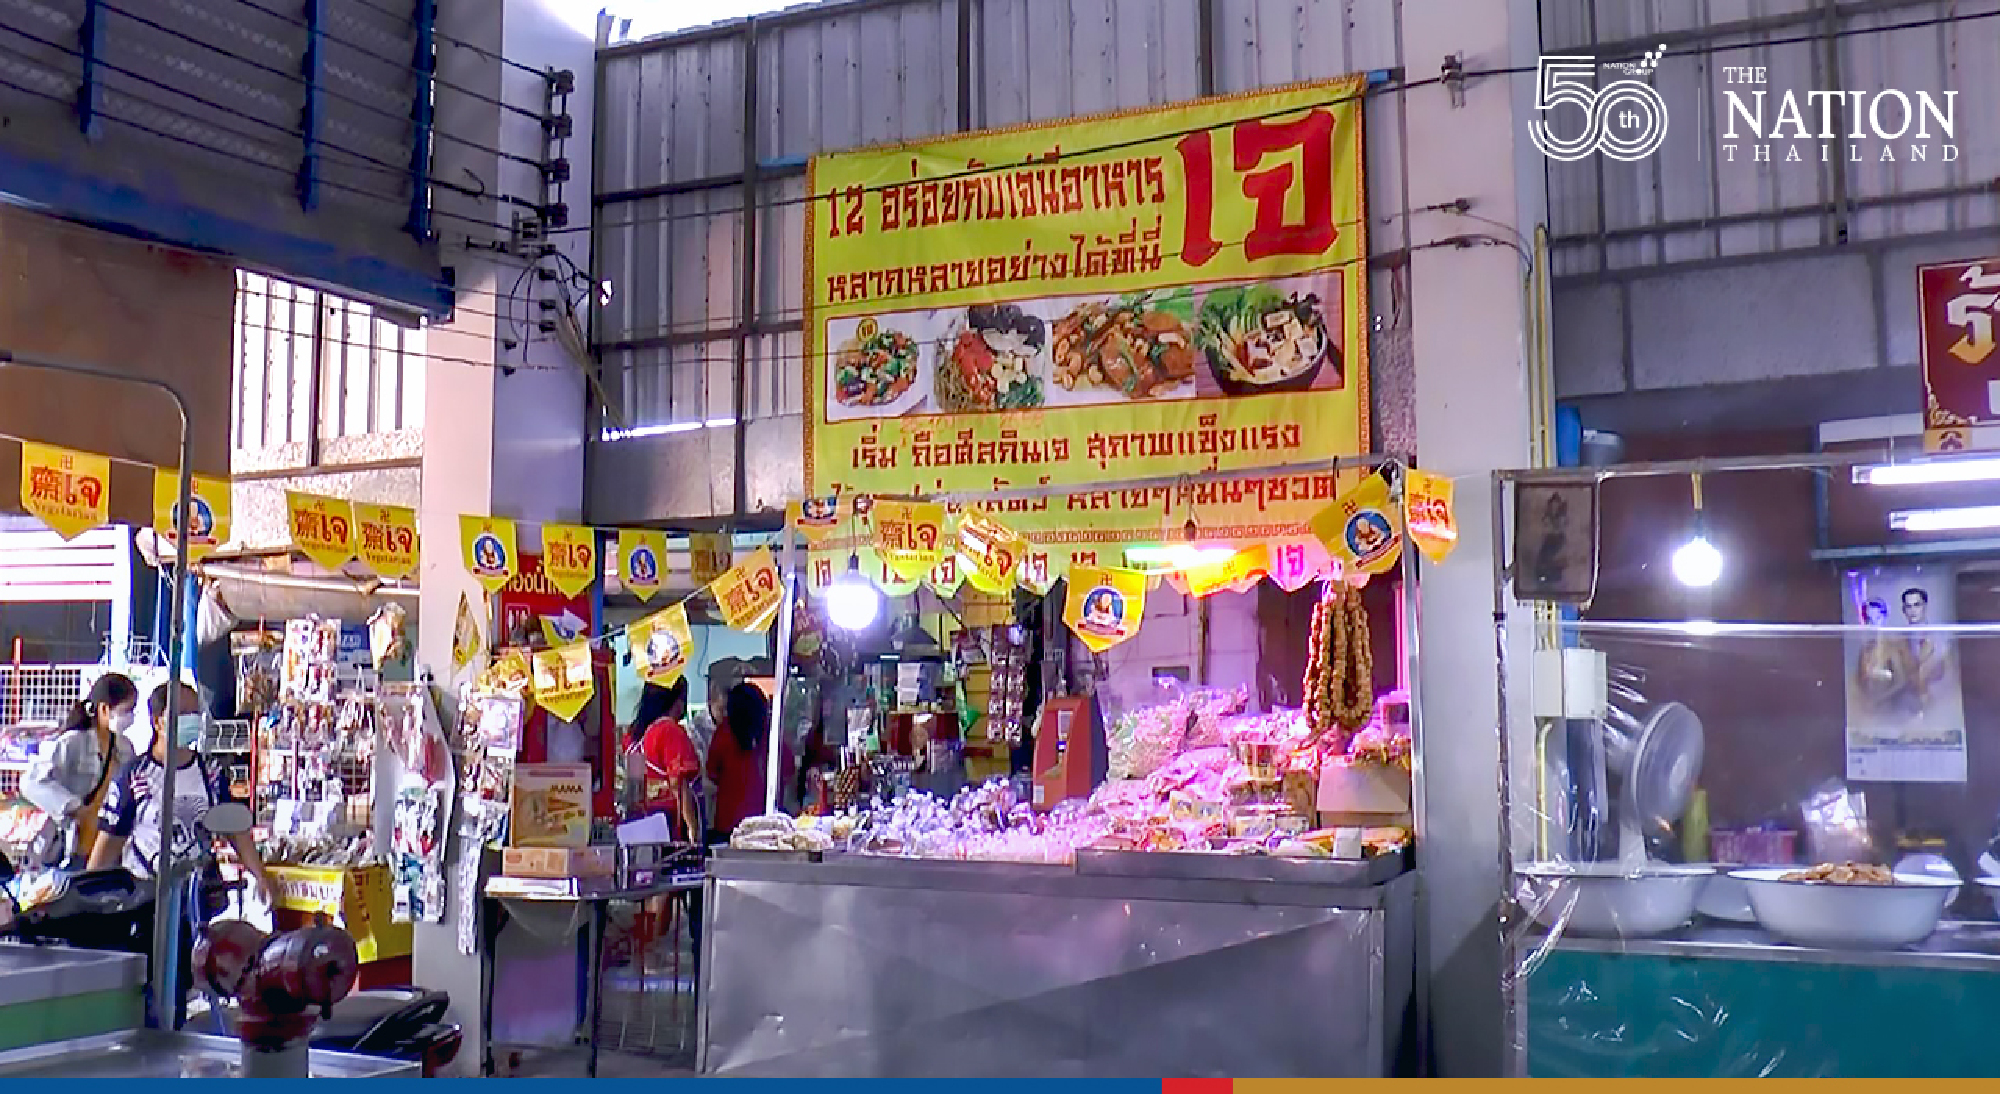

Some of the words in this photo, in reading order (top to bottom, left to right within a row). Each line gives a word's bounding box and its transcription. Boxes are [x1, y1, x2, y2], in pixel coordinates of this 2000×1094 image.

[829, 183, 866, 239] 12
[1175, 106, 1340, 267] เจ
[852, 424, 898, 468] เริ่ม
[550, 784, 584, 794] MAMA
